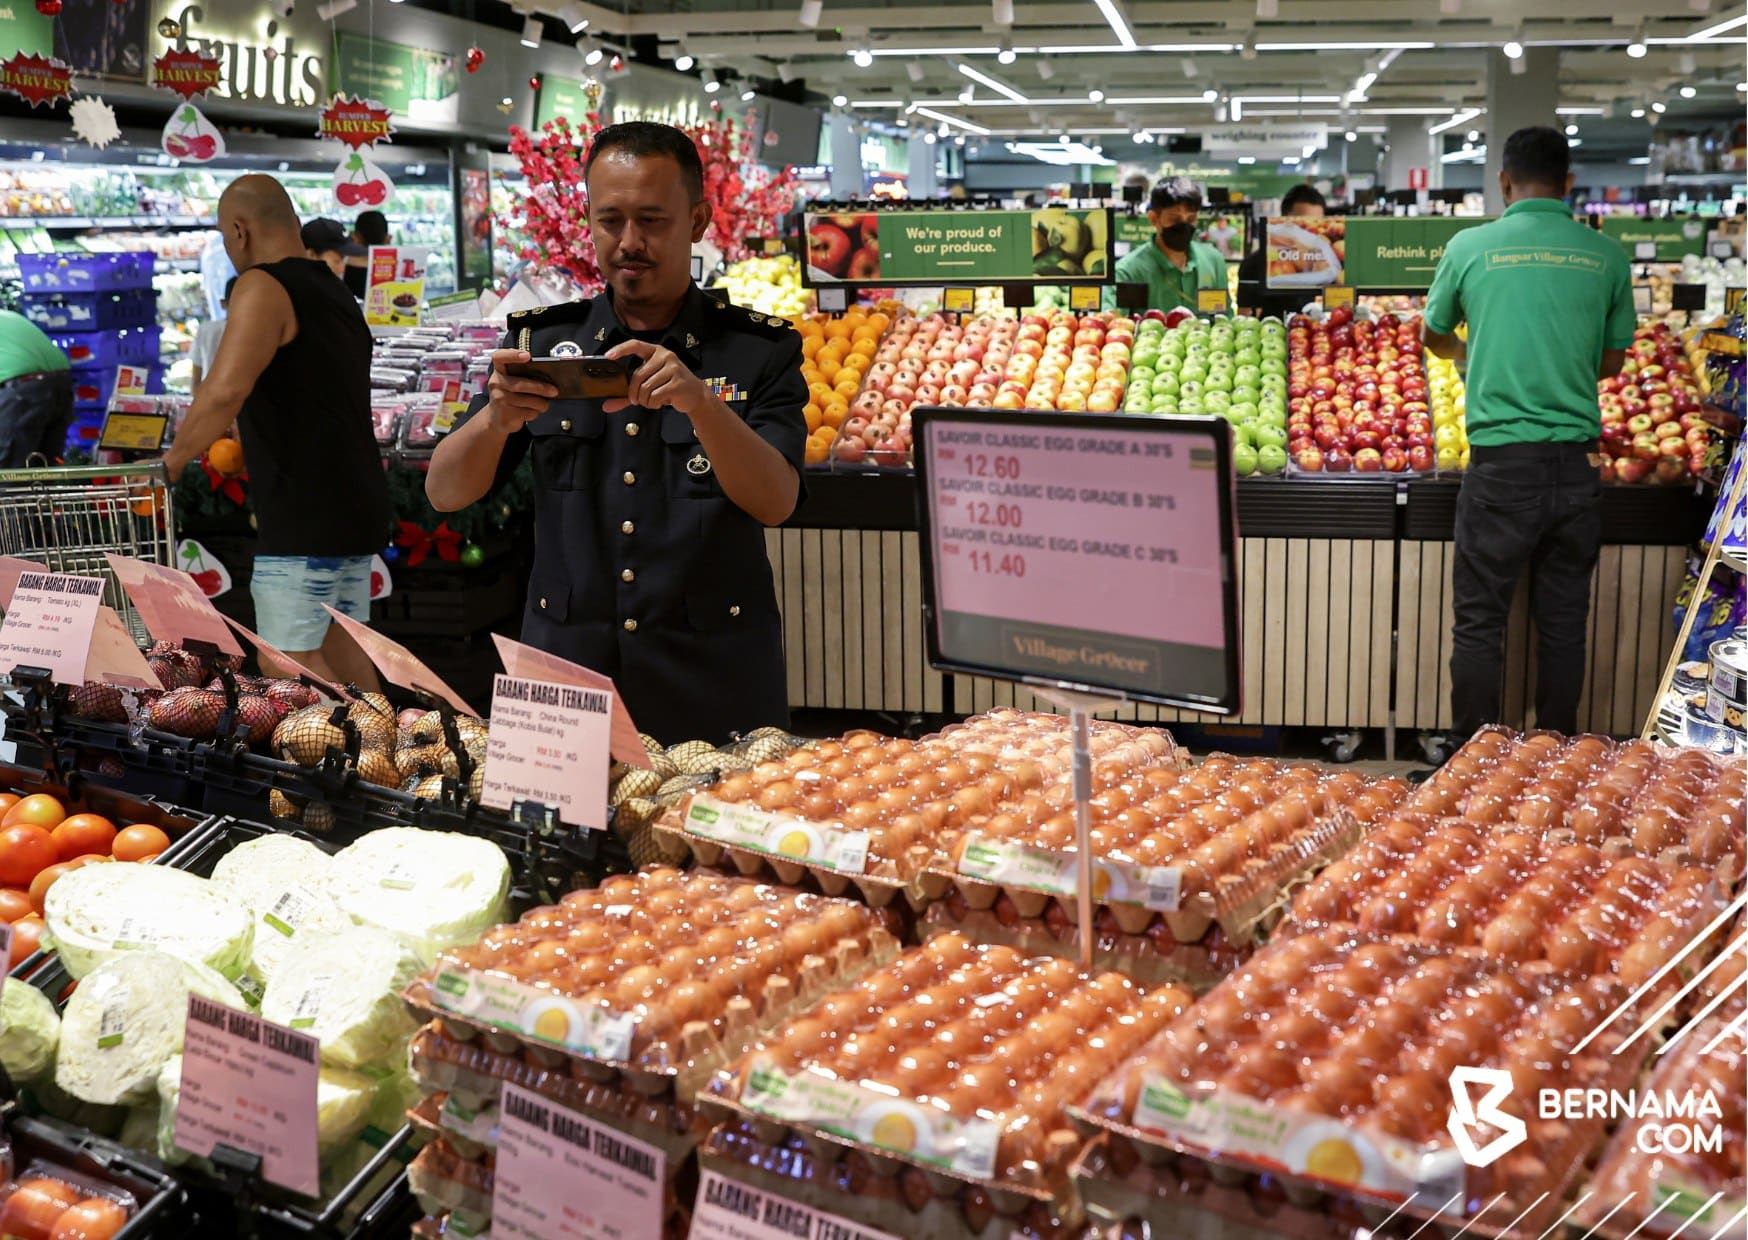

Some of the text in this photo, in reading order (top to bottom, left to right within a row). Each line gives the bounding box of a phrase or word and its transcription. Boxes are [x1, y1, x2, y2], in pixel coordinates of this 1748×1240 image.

[176, 5, 323, 108] fruits
[156, 68, 220, 83] HARVEST
[322, 118, 388, 133] HARVEST
[906, 226, 1002, 241] We're proud of
[914, 240, 996, 256] our produce.
[1278, 250, 1299, 261] Old
[1376, 246, 1426, 259] Rethink
[937, 430, 982, 444] SAVOIR
[985, 434, 1041, 450] CLASSIC
[1044, 437, 1074, 452] EGG
[1077, 438, 1126, 455] GRADE
[1130, 442, 1140, 454] A
[964, 454, 1020, 480] 12.60
[939, 478, 984, 492] SAVOIR
[988, 482, 1043, 499] CLASSIC
[1046, 486, 1077, 502] EGG
[1080, 488, 1129, 506] GRADE
[1132, 493, 1143, 506] B
[965, 502, 1022, 528] 12.00
[942, 526, 986, 542] SAVOIR
[990, 531, 1044, 550] CLASSIC
[1048, 536, 1078, 553] EGG
[1082, 538, 1132, 559] GRADE
[1134, 545, 1146, 561] C
[968, 550, 1026, 578] 11.40
[18, 574, 102, 596] BARANG HARGA TERKAWAL
[1013, 635, 1079, 664] Village
[496, 678, 608, 714] BARANG HARGA TERKAWAL
[190, 997, 316, 1064] BARANG HARGA TERKAWAL
[504, 1090, 549, 1133] BARANG
[552, 1112, 590, 1151] HARGA
[594, 1130, 657, 1182] TERKAWAL
[705, 1178, 762, 1221] BARANG
[763, 1197, 812, 1239] HARGA
